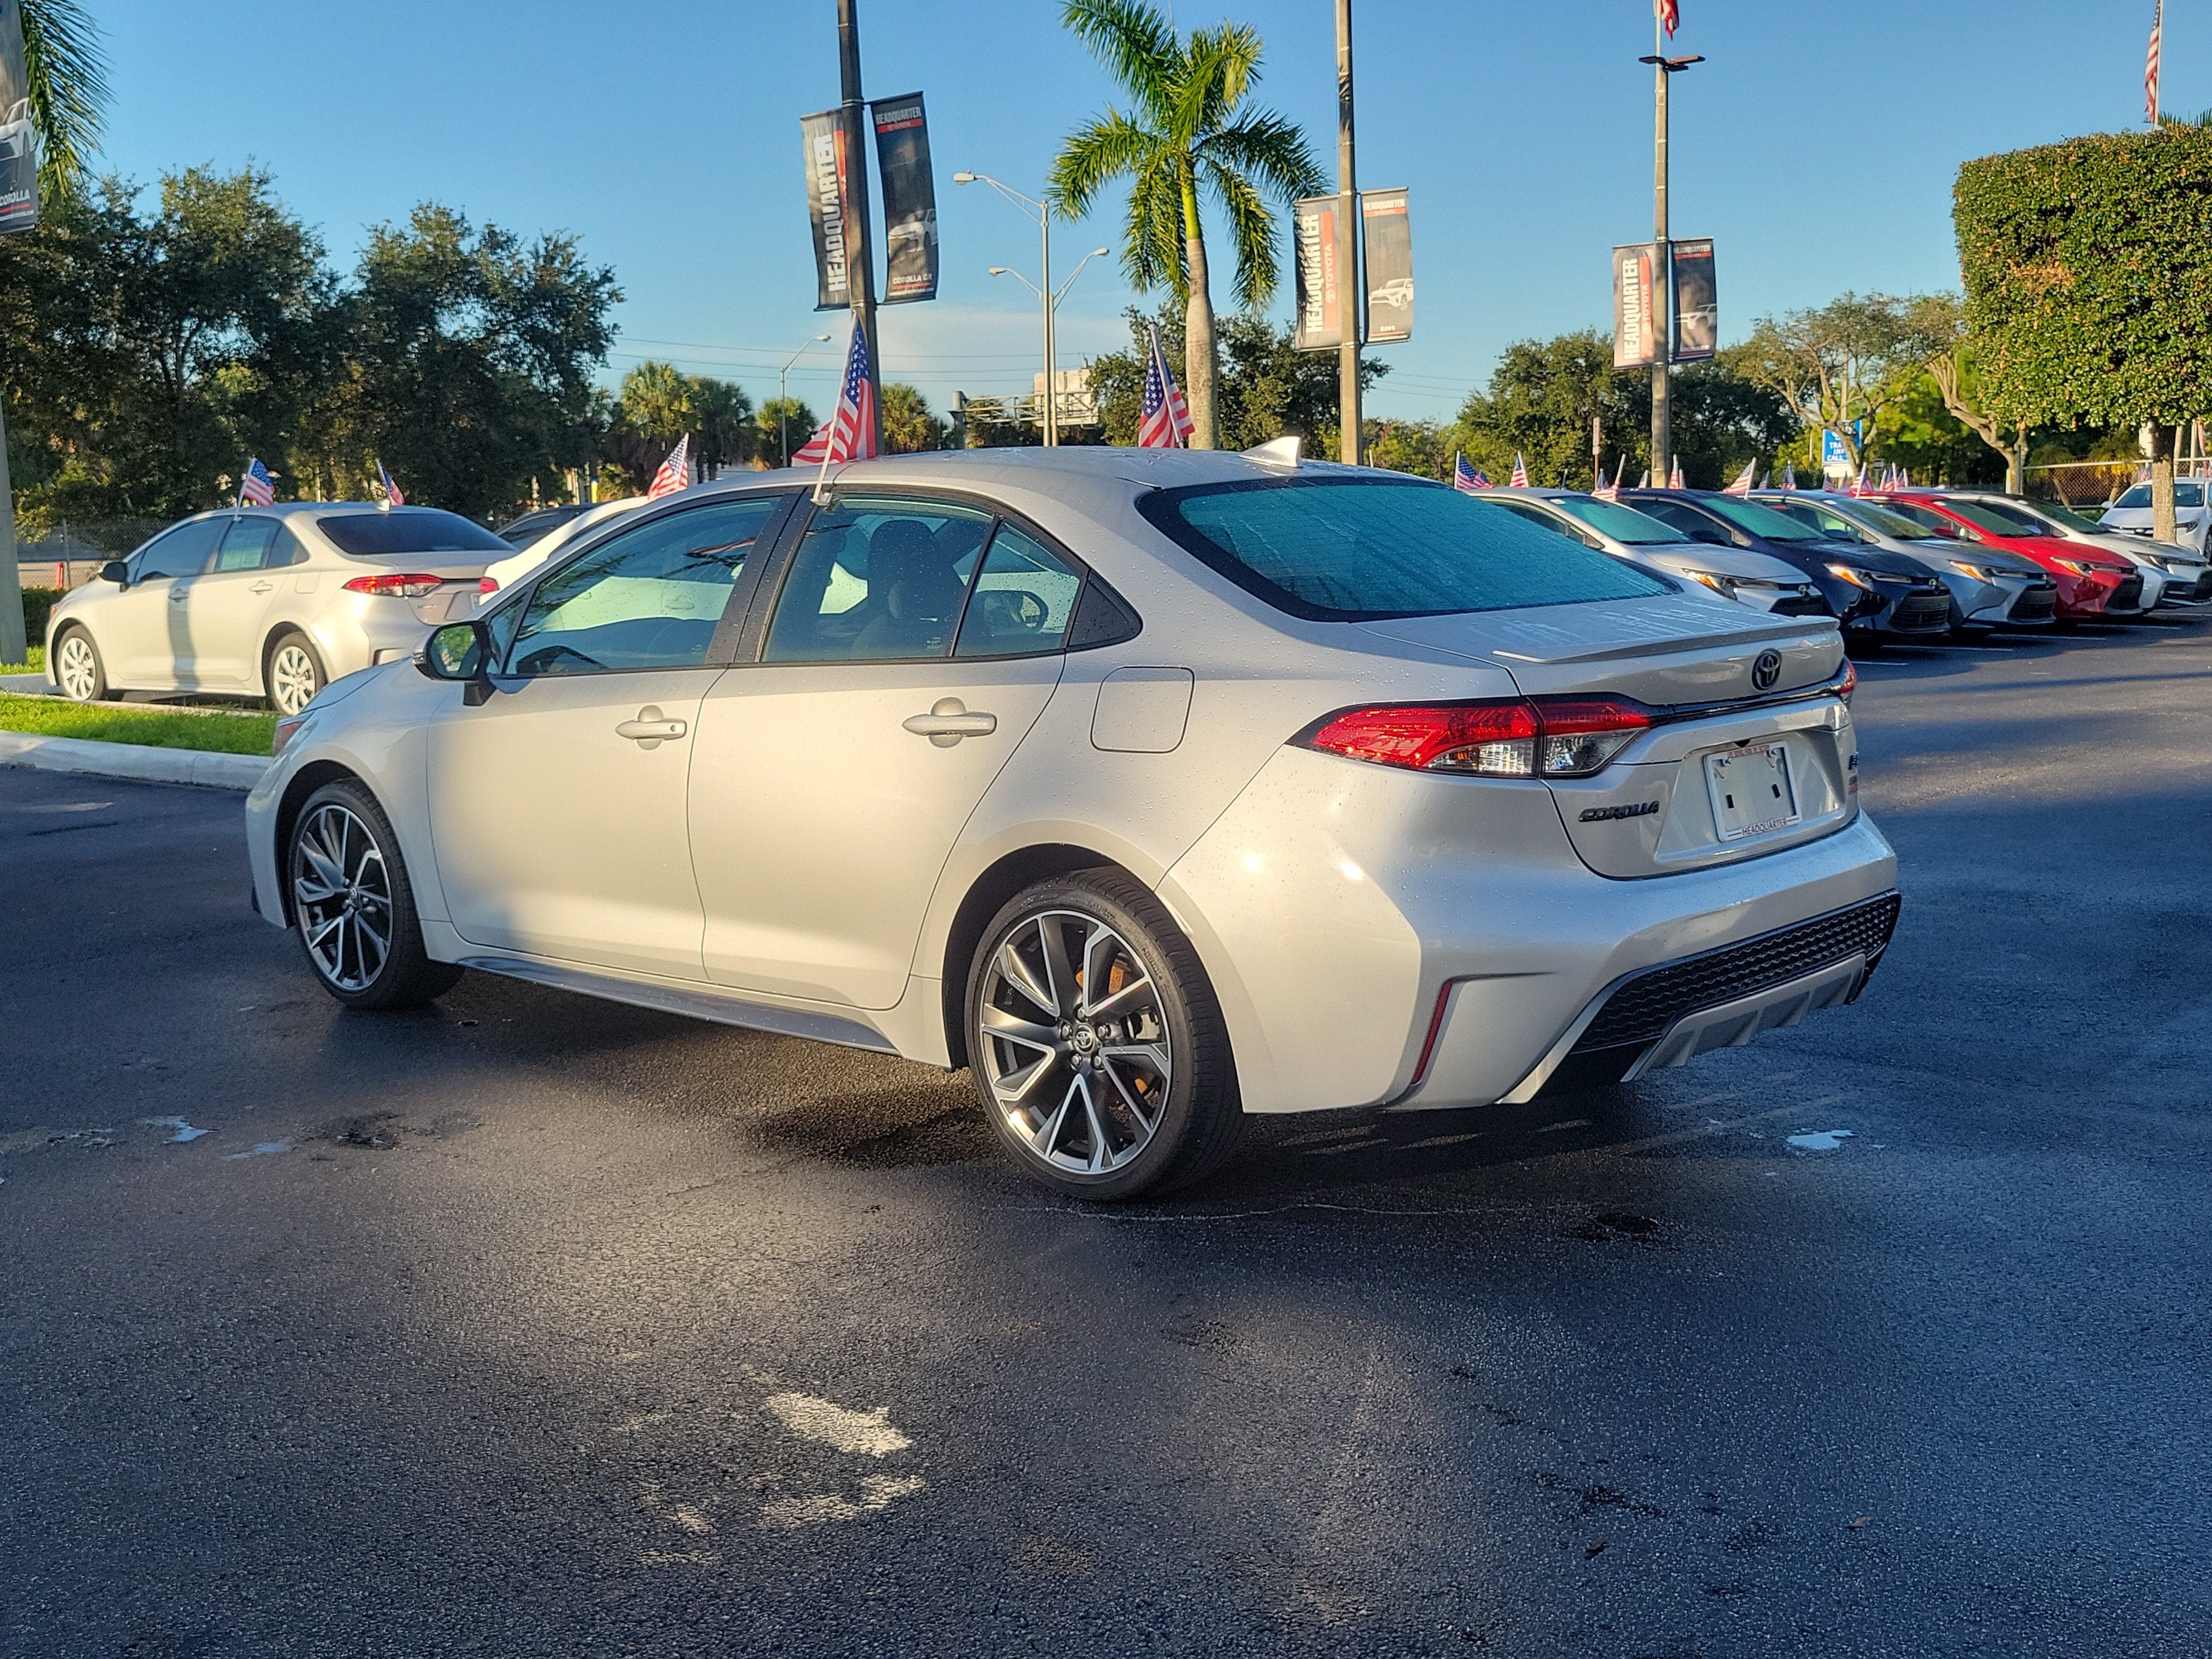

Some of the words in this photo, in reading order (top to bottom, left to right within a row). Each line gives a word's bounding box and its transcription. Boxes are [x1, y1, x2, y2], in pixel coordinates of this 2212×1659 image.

[0, 188, 30, 206] COROLLA
[813, 134, 847, 291] HEADQUARTER
[1302, 215, 1324, 333] HEADQUARTER
[1325, 243, 1334, 289] TOYOTA
[1622, 258, 1641, 359] HEADQUARTER
[1579, 800, 1660, 822] COROLLA
[1742, 817, 1787, 836] HEADQUARTER
